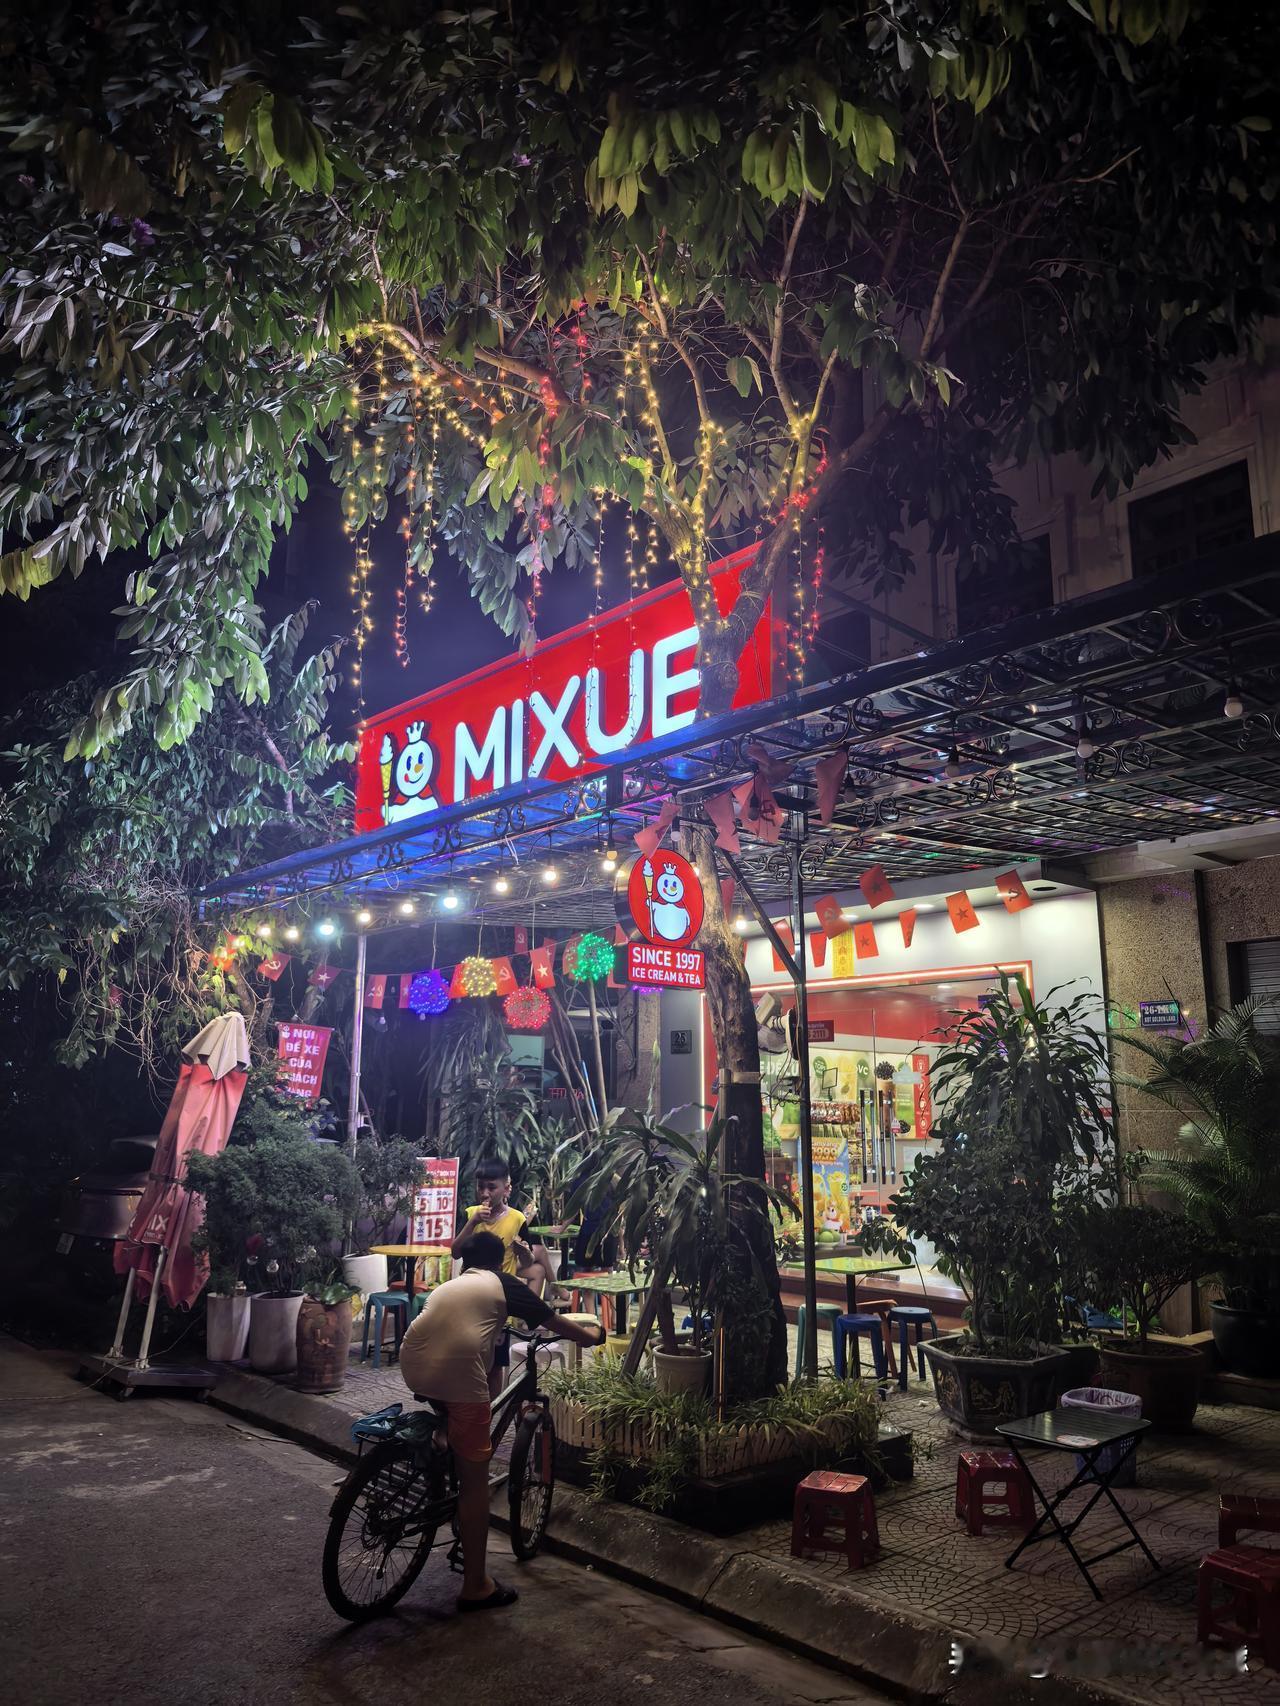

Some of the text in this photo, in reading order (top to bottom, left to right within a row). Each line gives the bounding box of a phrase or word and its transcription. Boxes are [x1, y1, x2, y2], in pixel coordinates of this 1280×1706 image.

[454, 625, 701, 803] MIXUE
[632, 946, 701, 971] SINCE 1997
[632, 966, 646, 979] ICE
[293, 1028, 315, 1039] NƠI
[304, 1044, 320, 1056] XE
[289, 1056, 312, 1069] CỦA
